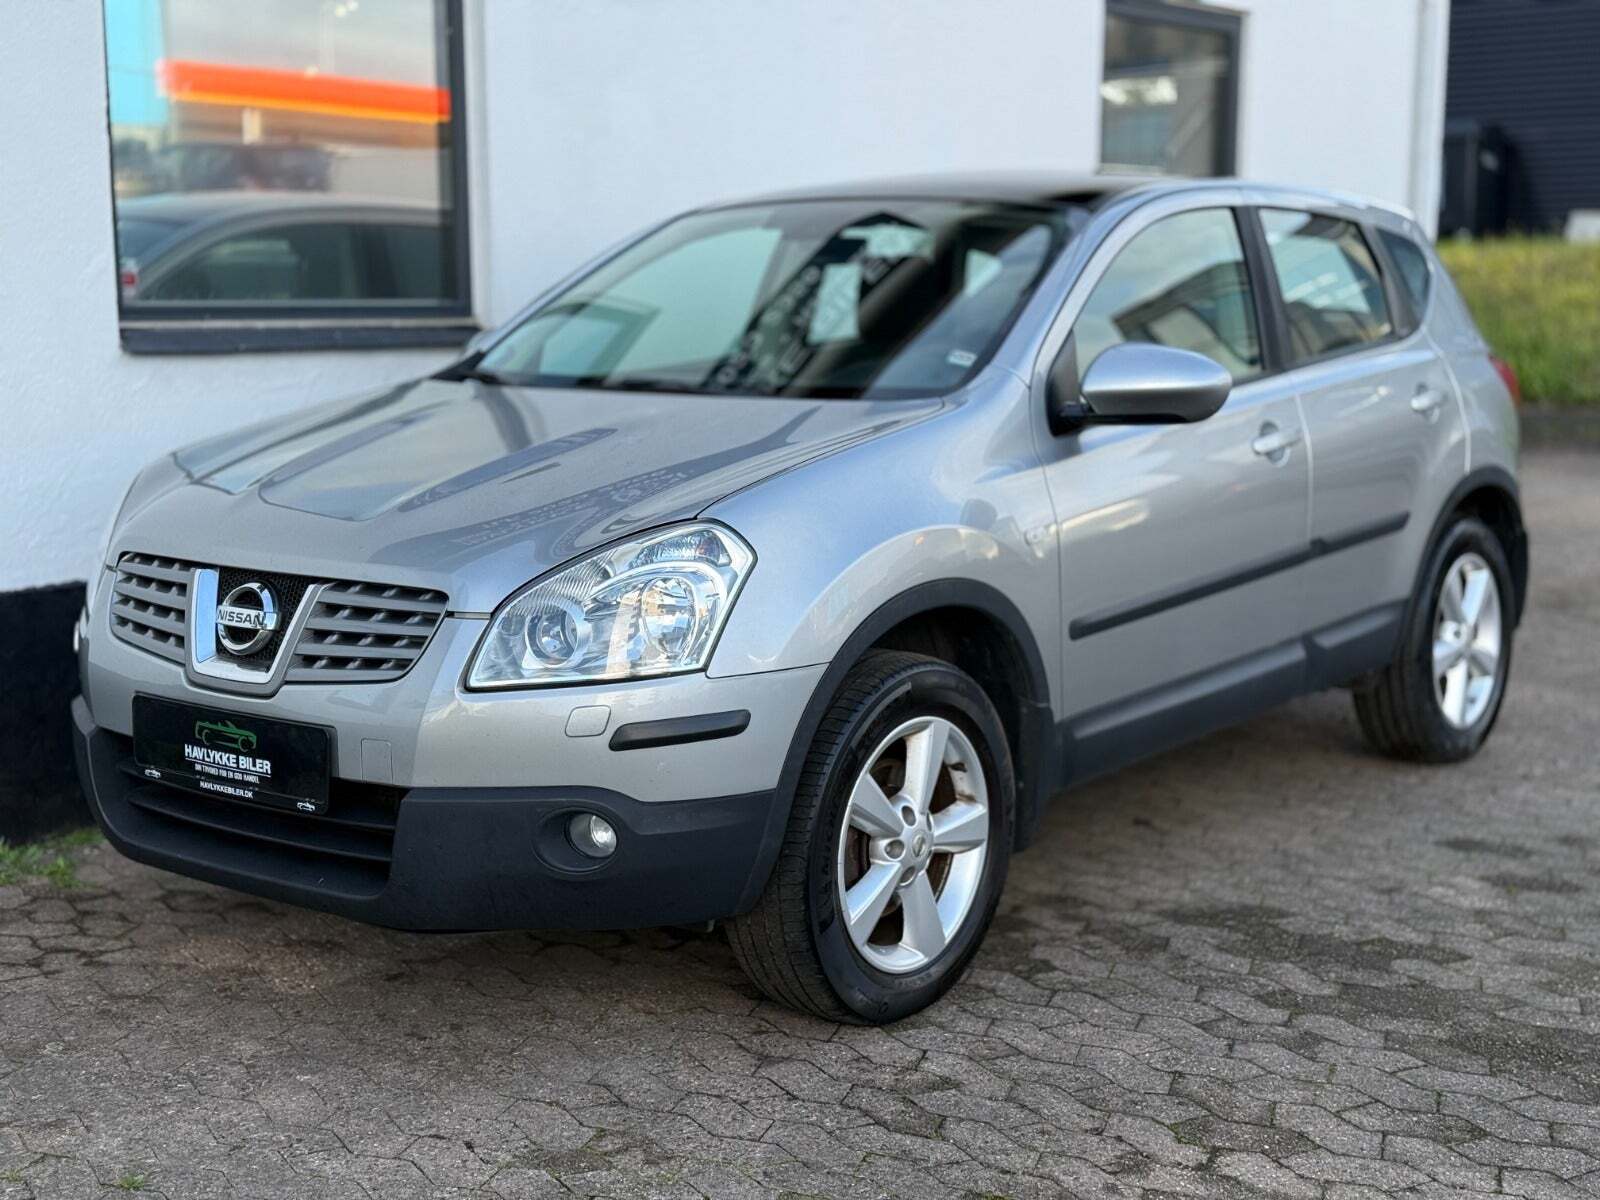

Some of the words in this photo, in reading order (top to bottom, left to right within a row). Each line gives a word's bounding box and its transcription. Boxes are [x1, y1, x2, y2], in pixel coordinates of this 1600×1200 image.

[217, 608, 265, 627] NISSAN
[184, 743, 237, 768] HAVLYKKE
[238, 755, 272, 775] BILER
[200, 780, 254, 799] HAVLYKKEBILER.DK
